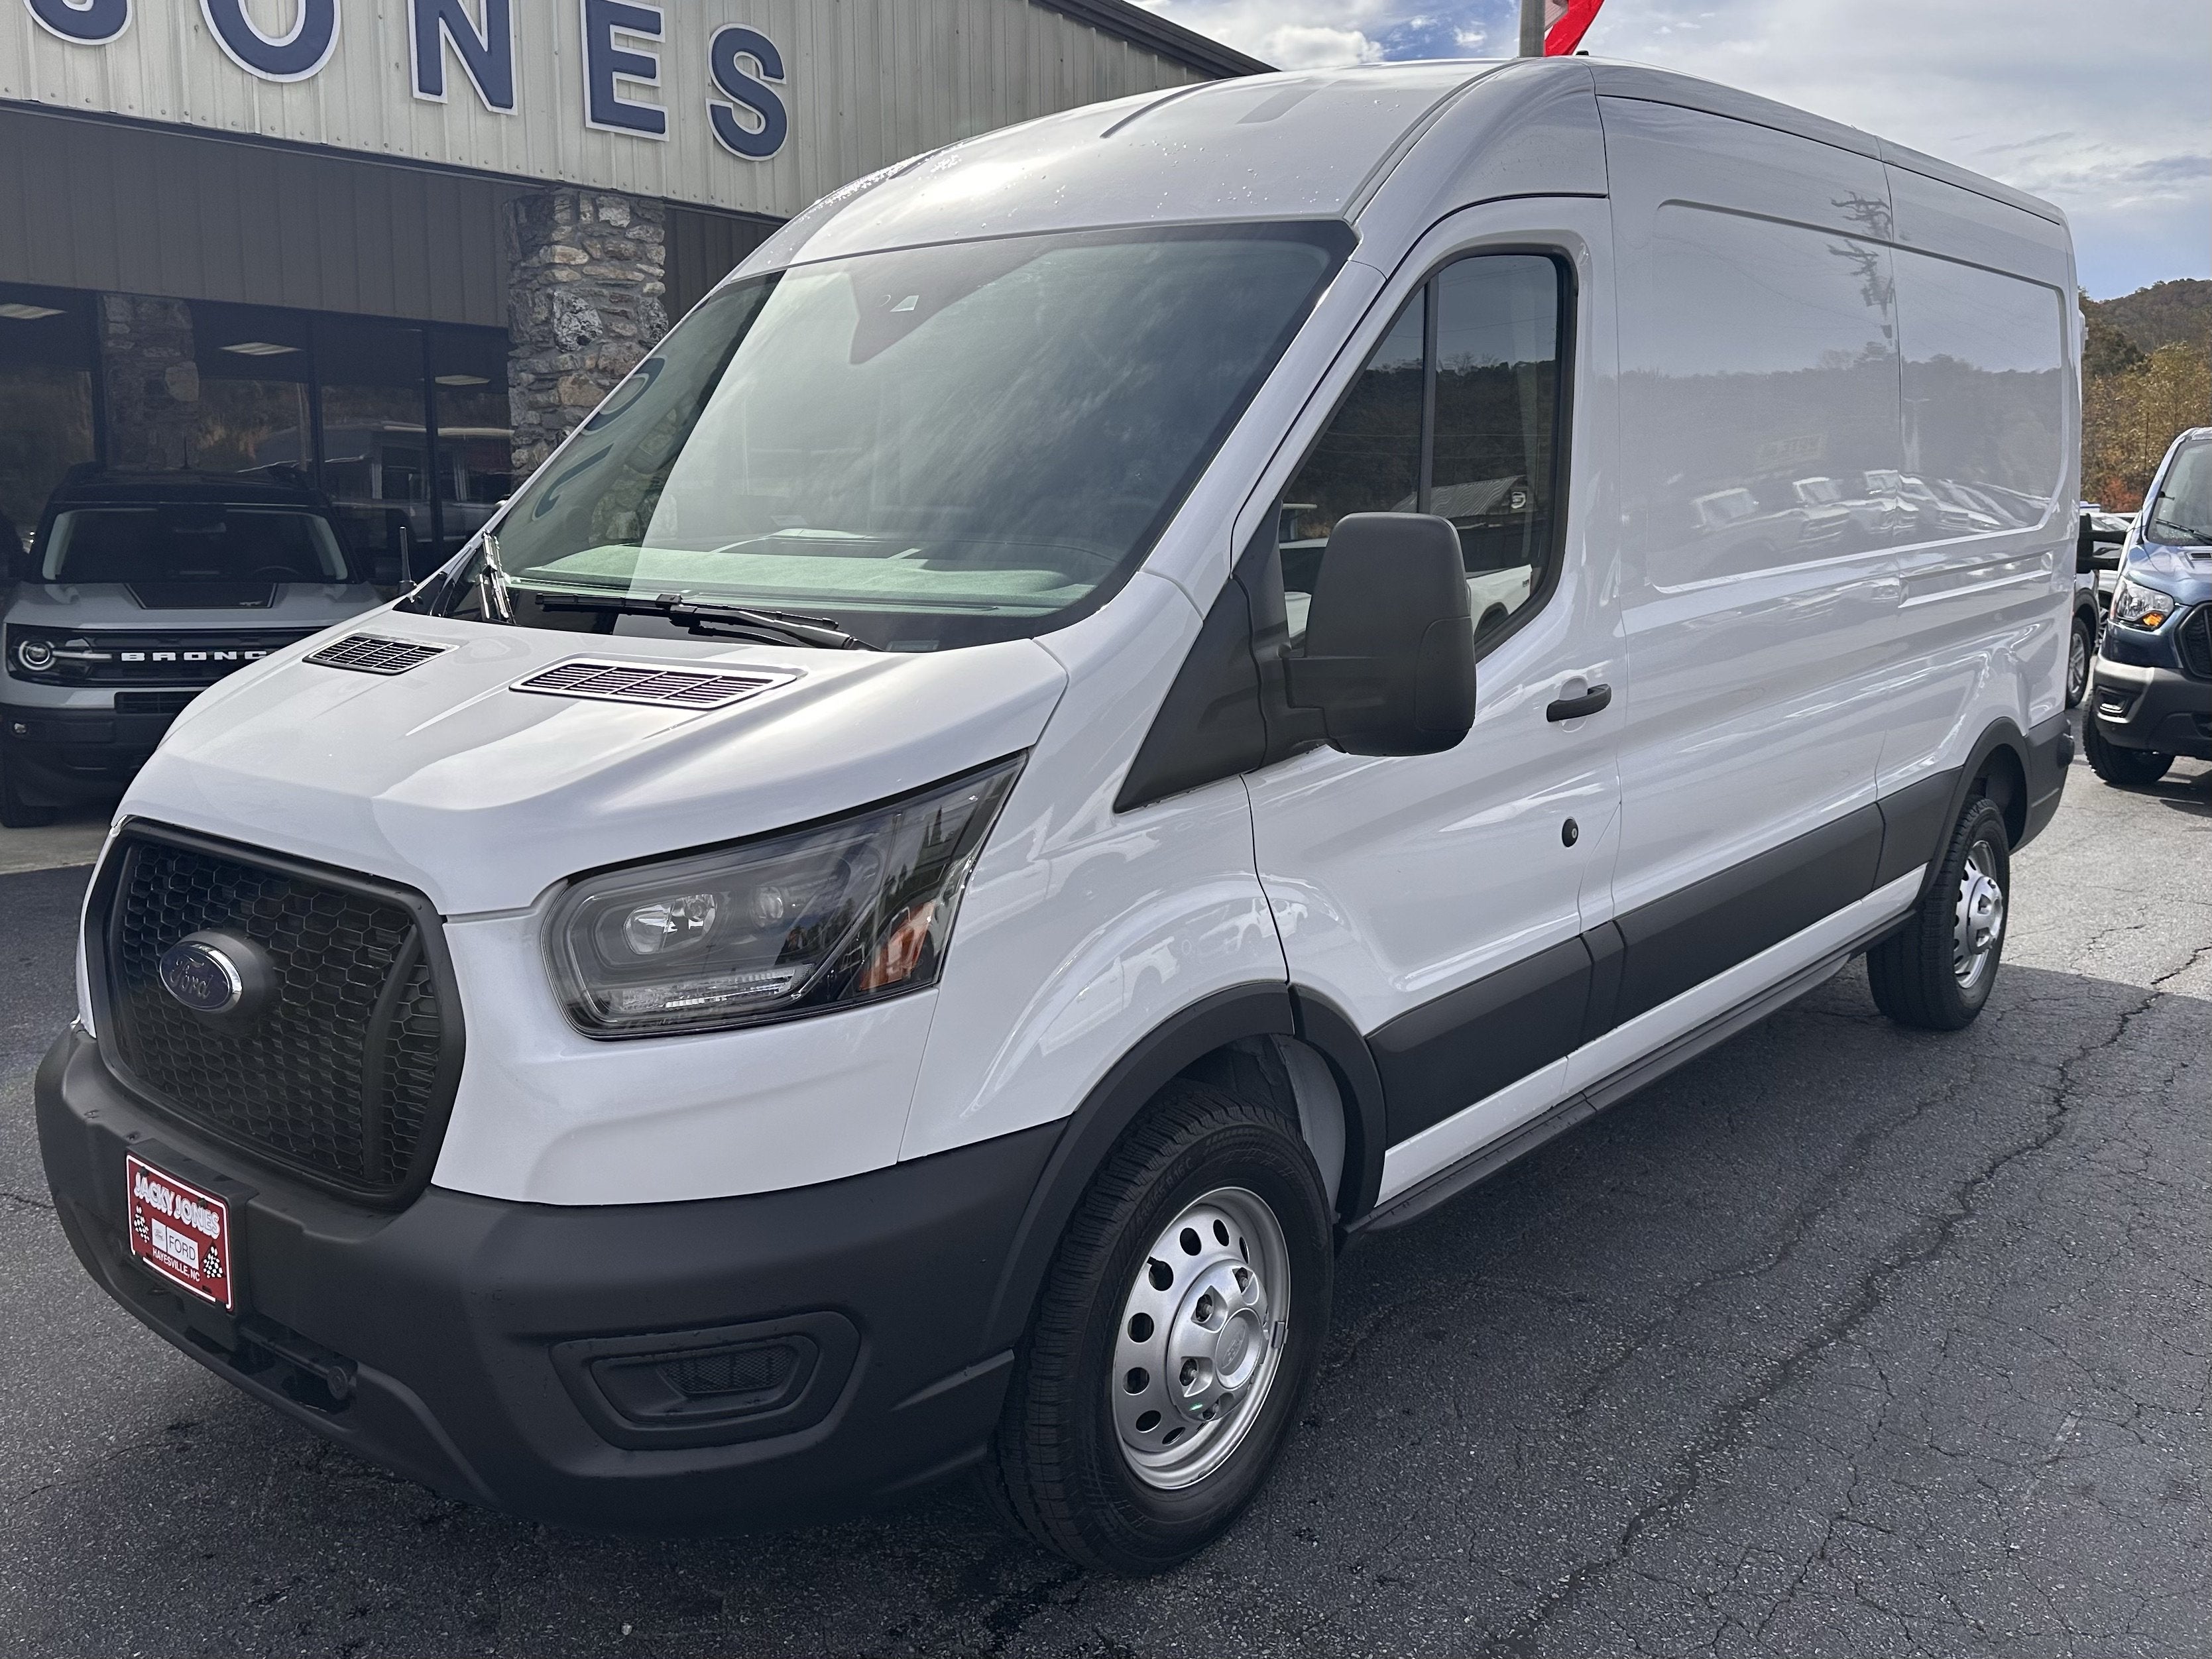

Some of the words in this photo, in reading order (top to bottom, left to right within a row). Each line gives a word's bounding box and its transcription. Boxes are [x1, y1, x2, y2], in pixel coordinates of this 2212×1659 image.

[133, 1171, 175, 1217] JACKY
[174, 1194, 220, 1239] JONES
[152, 1248, 190, 1279] HAYESVILLE,
[190, 1268, 200, 1282] NC
[169, 1235, 196, 1261] FORD
